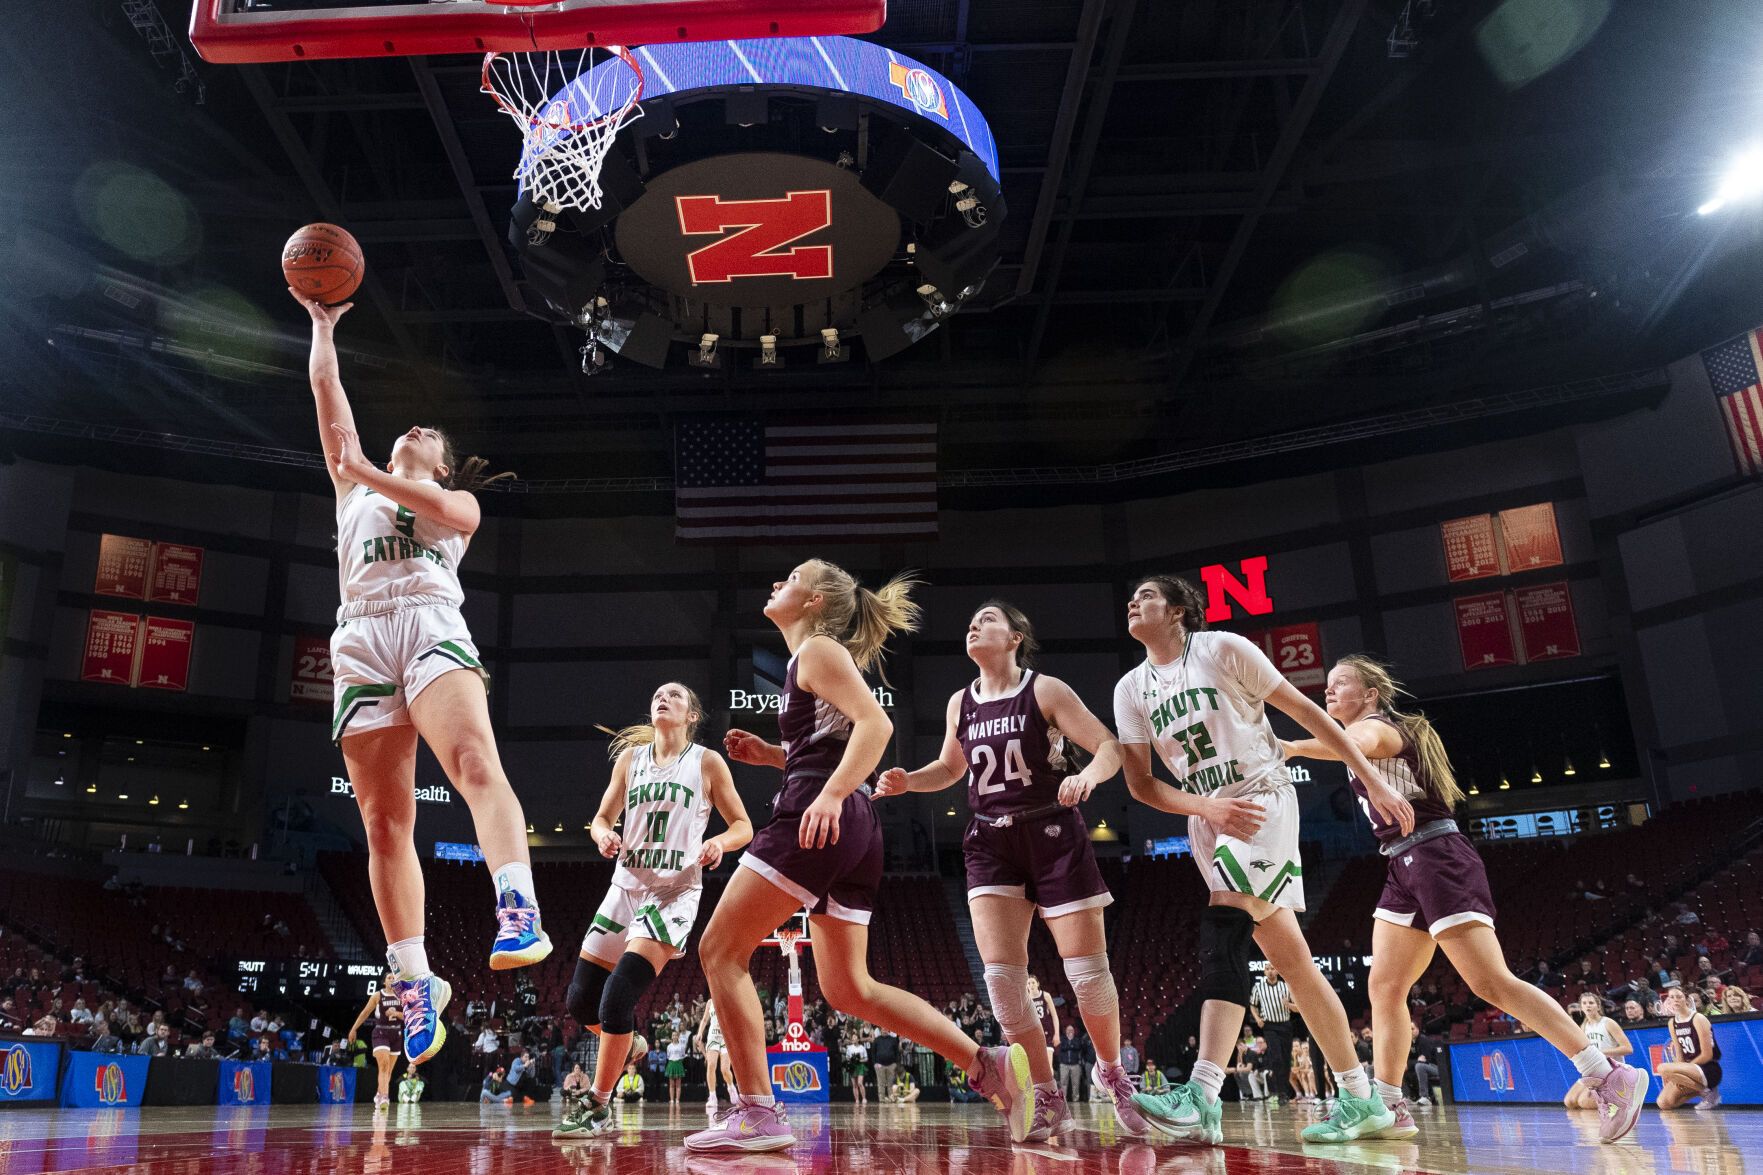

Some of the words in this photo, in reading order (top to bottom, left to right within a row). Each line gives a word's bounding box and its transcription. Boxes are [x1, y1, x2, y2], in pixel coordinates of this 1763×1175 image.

[675, 189, 833, 282] N
[1200, 555, 1274, 623] N
[1280, 643, 1315, 668] 23
[1483, 653, 1495, 663] N
[1546, 644, 1557, 655] N
[101, 668, 112, 678] N
[158, 674, 168, 684] N
[298, 655, 335, 680] 22
[729, 689, 781, 714] Brya
[1150, 687, 1220, 738] SKUTT
[968, 715, 1027, 741] WAVERLY
[971, 738, 1033, 796] 24
[413, 785, 450, 802] ealth
[628, 782, 695, 811] SKUTT
[644, 811, 670, 842] 10
[347, 964, 384, 976] WAVERLY
[366, 980, 377, 996] 8
[781, 1039, 811, 1052] fnbo
[1677, 1035, 1696, 1054] 30
